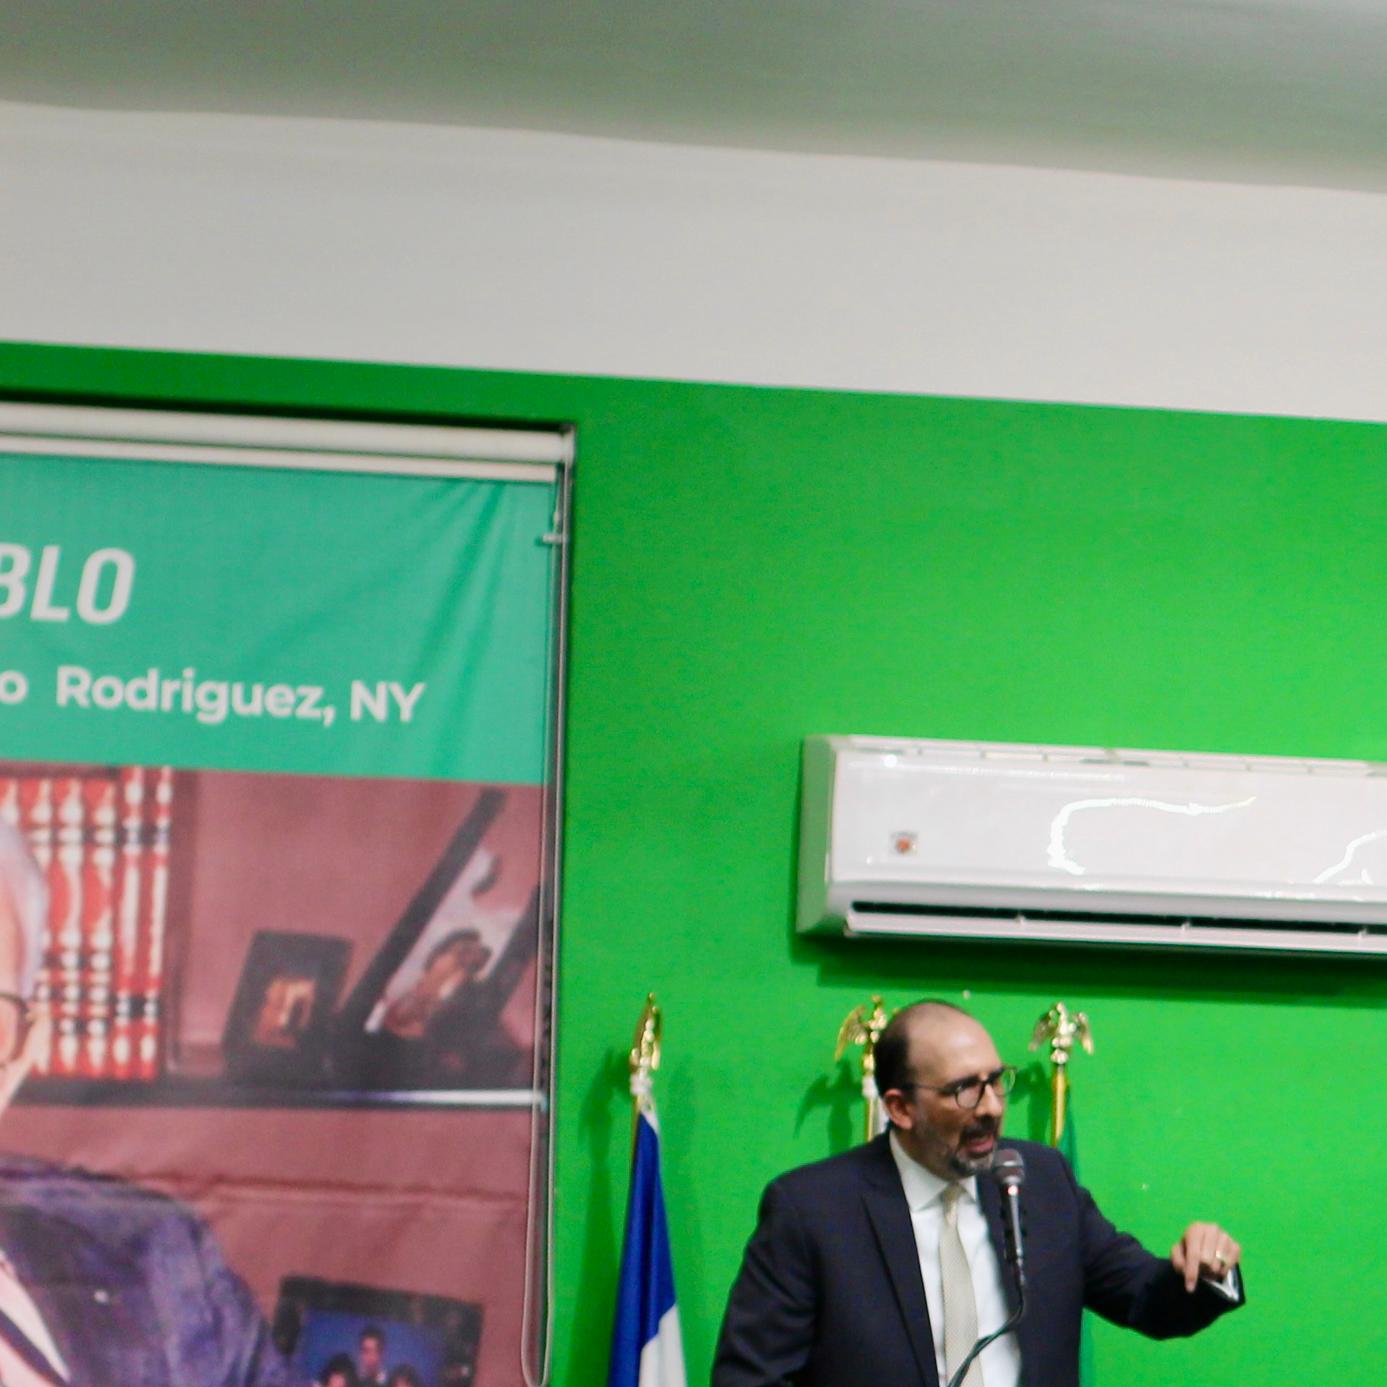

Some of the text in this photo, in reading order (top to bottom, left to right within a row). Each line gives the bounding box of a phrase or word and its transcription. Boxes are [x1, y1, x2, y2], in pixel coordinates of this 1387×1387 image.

[0, 542, 136, 625] BLO
[56, 665, 337, 727] Rodriguez,
[349, 680, 428, 722] NY
